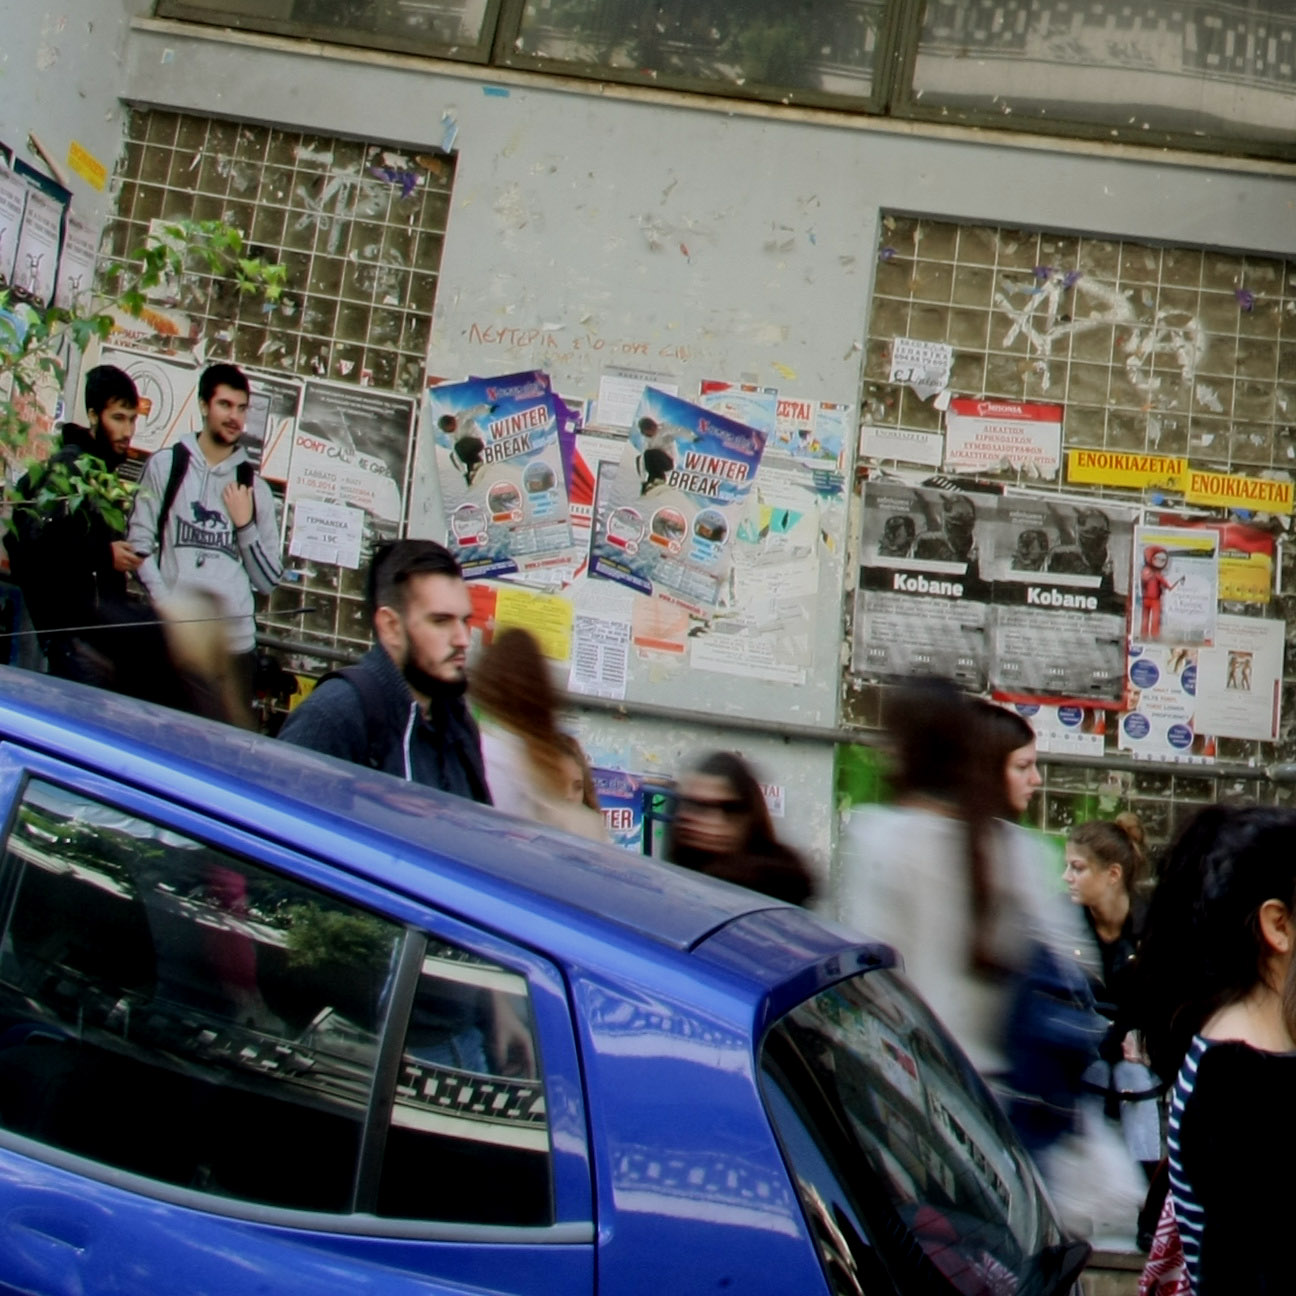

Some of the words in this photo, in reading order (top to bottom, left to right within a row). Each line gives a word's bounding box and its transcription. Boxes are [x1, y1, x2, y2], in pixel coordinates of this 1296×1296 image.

[489, 406, 549, 440] WINTER
[484, 435, 533, 465] BREAK
[1077, 451, 1183, 474] ΕΝΟΙΚΙΑΖΕΤΑΙ
[685, 453, 748, 480] WINTER
[668, 471, 720, 497] BREAK
[1190, 472, 1290, 503] ΕΝΟΙΚΙΑΖΕΤΑΙ
[174, 515, 238, 562] LONSDAL
[893, 573, 964, 597] Kobane
[1027, 586, 1098, 610] Kobane
[601, 809, 632, 829] TER
